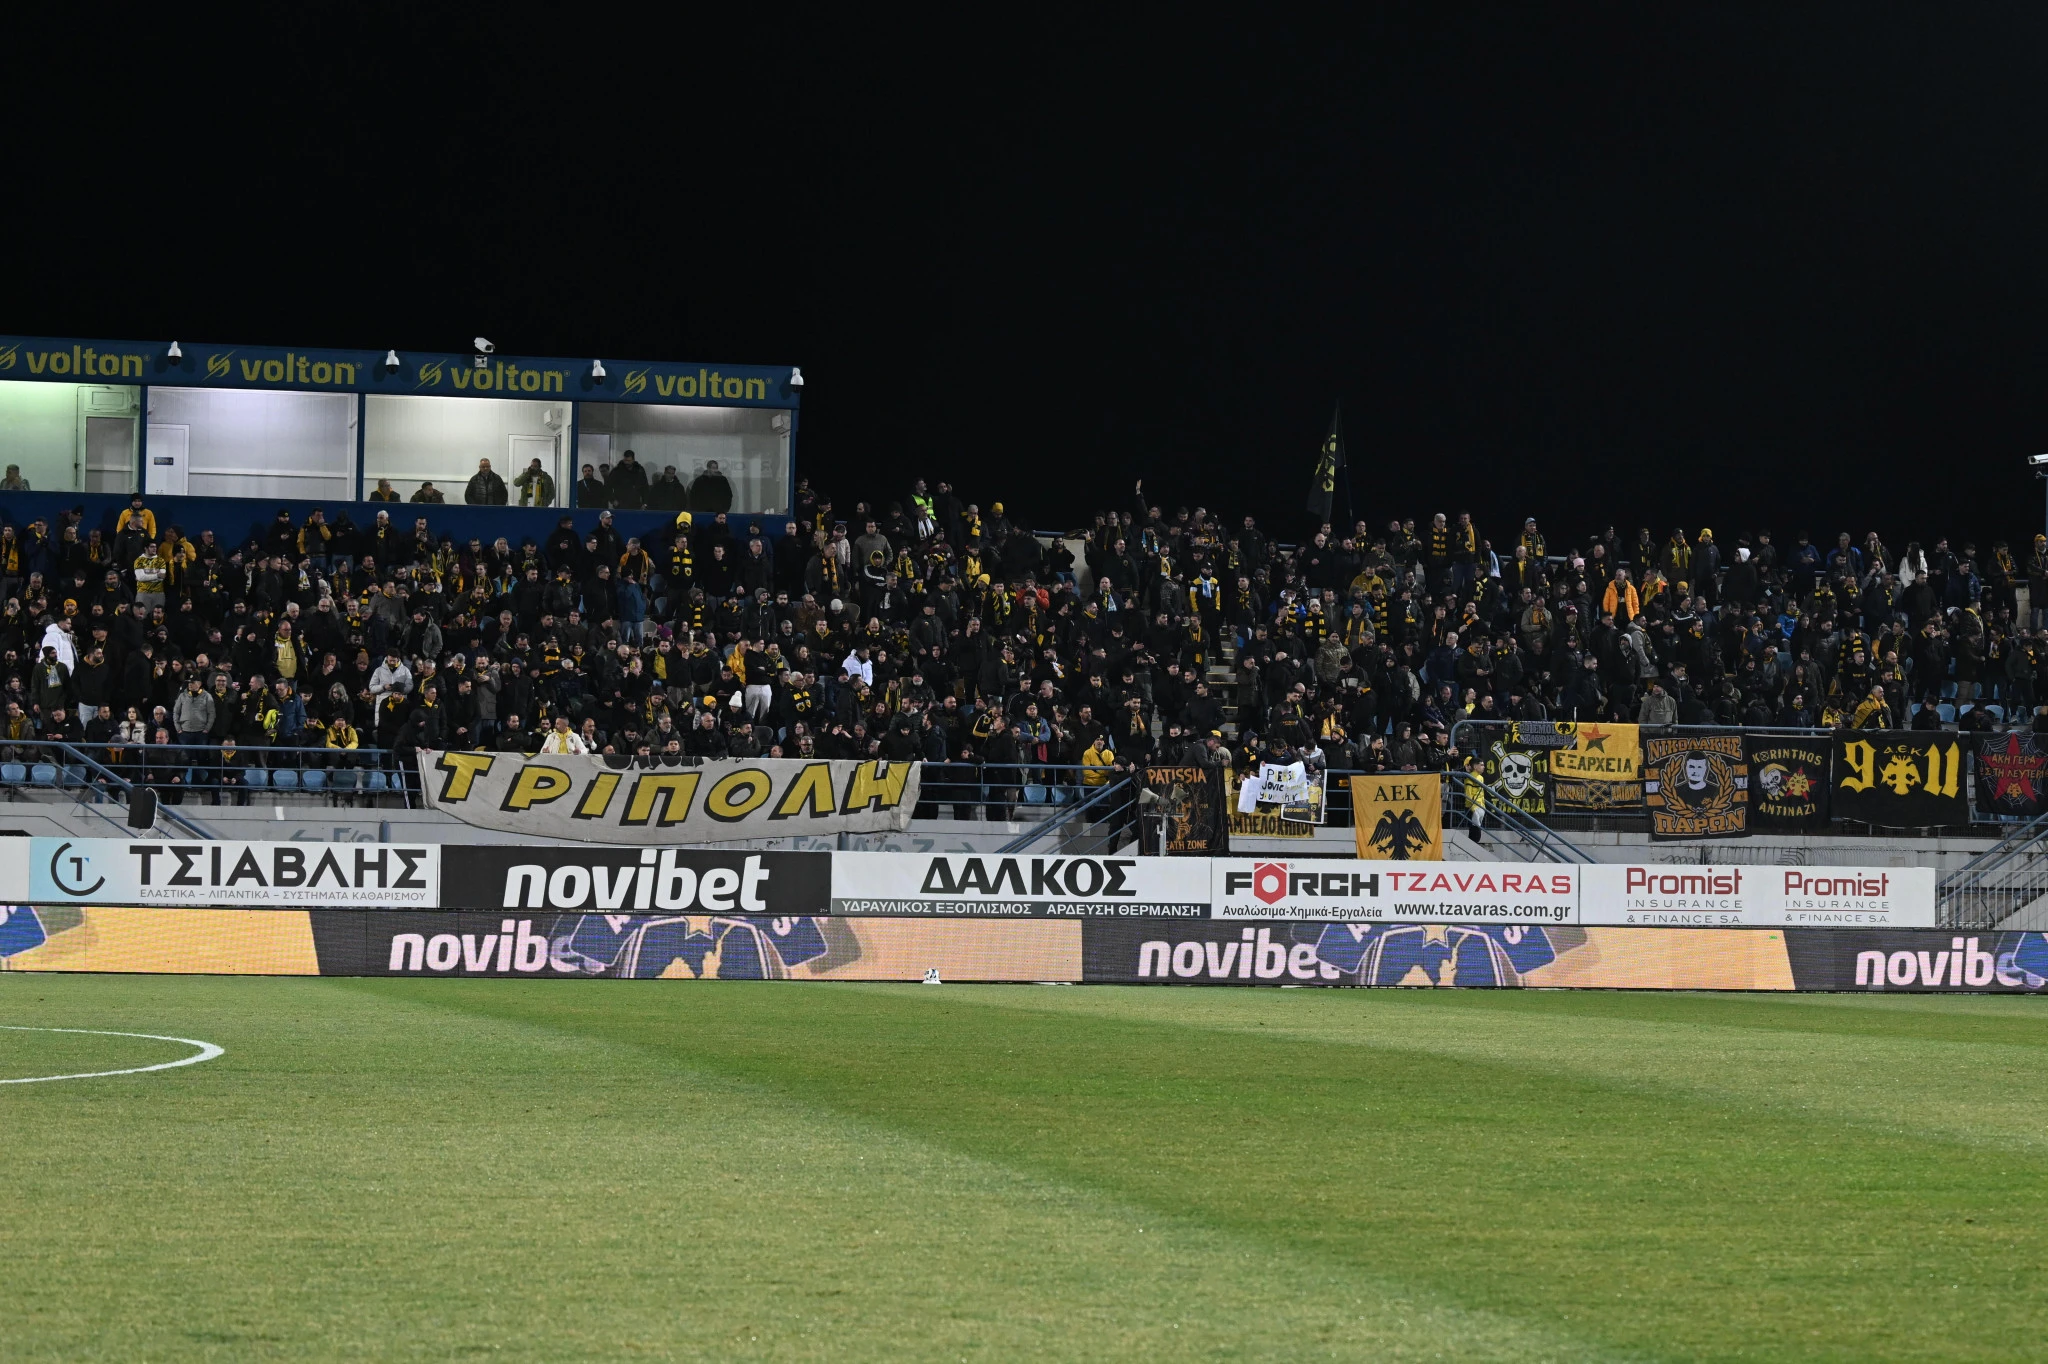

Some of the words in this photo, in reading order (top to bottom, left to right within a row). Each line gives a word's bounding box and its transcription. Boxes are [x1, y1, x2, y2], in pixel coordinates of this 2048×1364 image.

[26, 345, 143, 377] volton
[240, 352, 355, 385] volton
[450, 361, 563, 393] volton
[655, 368, 766, 400] volton
[1647, 736, 1742, 764] ΝΙΚΟΛΑΚΗΣ
[1991, 754, 2011, 765] ΑΚΗ
[2012, 755, 2036, 766] ΓΕΡΑ
[1486, 759, 1495, 775] 9
[1534, 759, 1548, 774] 11
[1555, 752, 1632, 773] ΕΞΑΡΧΕΙΑ
[1839, 739, 1877, 793] 9
[1146, 768, 1207, 785] PATISSIA
[437, 751, 912, 827] ΤΡΙΠΟΛΗ
[1373, 784, 1422, 802] ΑΕΚ
[1758, 802, 1816, 817] ANTINAZI
[1653, 807, 1747, 835] ΠΑΡΩΝ
[1165, 840, 1186, 850] EATH
[1187, 838, 1207, 849] ZONE
[129, 845, 427, 888] ΤΣΙΑΒΛΗΣ
[919, 857, 1137, 897] ΔΑΛΚΟΣ
[503, 849, 770, 911] novibet
[1386, 872, 1571, 894] TZAVARAS
[1626, 867, 1743, 895] Promist
[1784, 871, 1889, 897] Promist
[140, 889, 195, 898] ΕΛΑΣΤΙΚΑ
[208, 890, 270, 899] ΛΙΠΑΝΤΙΚΑ
[283, 890, 349, 900] ΣΥΣΤΗΜΑΤΑ
[352, 892, 426, 901] ΚΑΘΑΡΙΣΜΟΥ
[1626, 899, 1743, 909] INSURANCE
[1784, 900, 1889, 909] INSURANCE
[841, 900, 932, 913] ΥΔΡΑΥΛΙΚΟΣ
[935, 901, 1032, 915] ΕΞΟΠΛΙΣΜΟΣ
[1046, 903, 1114, 915] ΑΡΔΕΥΣΗ
[1118, 904, 1201, 916] ΘΕΡΜΑΝΣΗ
[1222, 903, 1383, 919] Αναλώσιμα-Χημικά-Εργαλεία
[1394, 902, 1571, 921] www.tzavaras.com.gr
[1785, 914, 1793, 922] &
[1796, 914, 1864, 923] FINANCE
[1868, 914, 1889, 923] S.A.
[1626, 914, 1636, 923] &
[1639, 914, 1715, 924] FINANCE
[1719, 914, 1743, 924] S.A.
